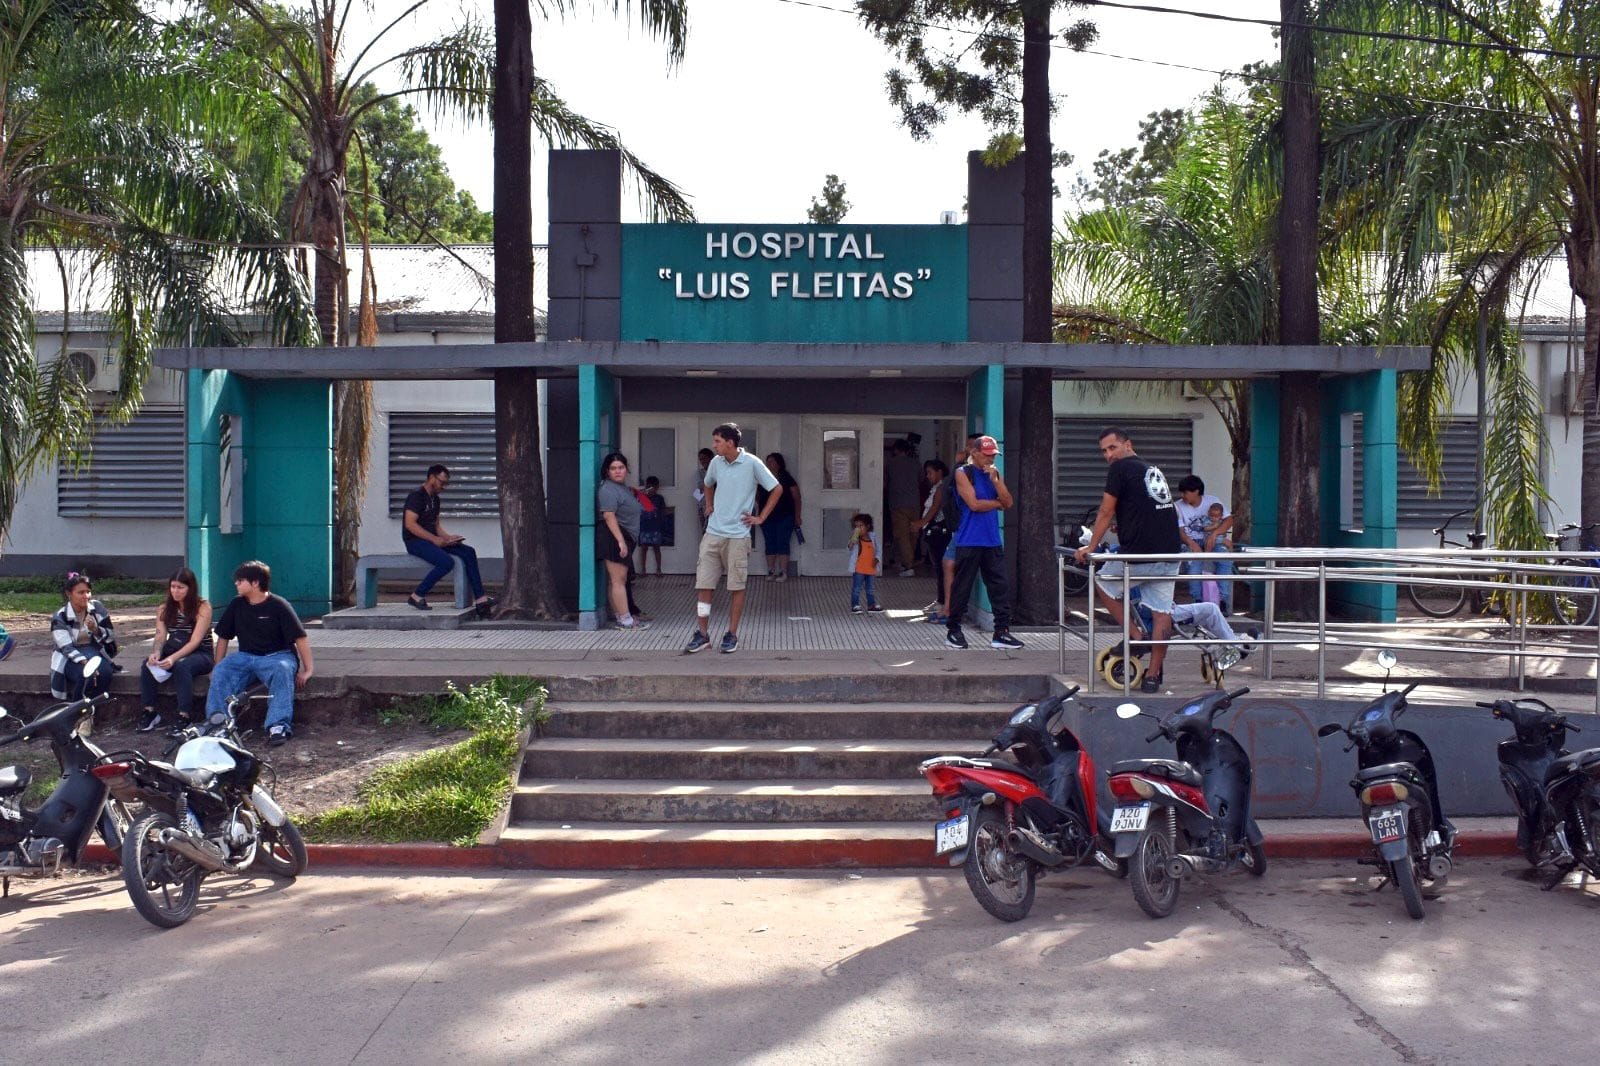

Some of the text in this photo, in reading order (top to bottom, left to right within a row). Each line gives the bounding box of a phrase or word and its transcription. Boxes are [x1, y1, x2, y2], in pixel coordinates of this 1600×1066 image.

[705, 231, 885, 259] HOSPITAL
[658, 267, 932, 299] “LUIS FLEITAS”
[1377, 816, 1396, 829] 665
[1378, 826, 1399, 839] LAN
